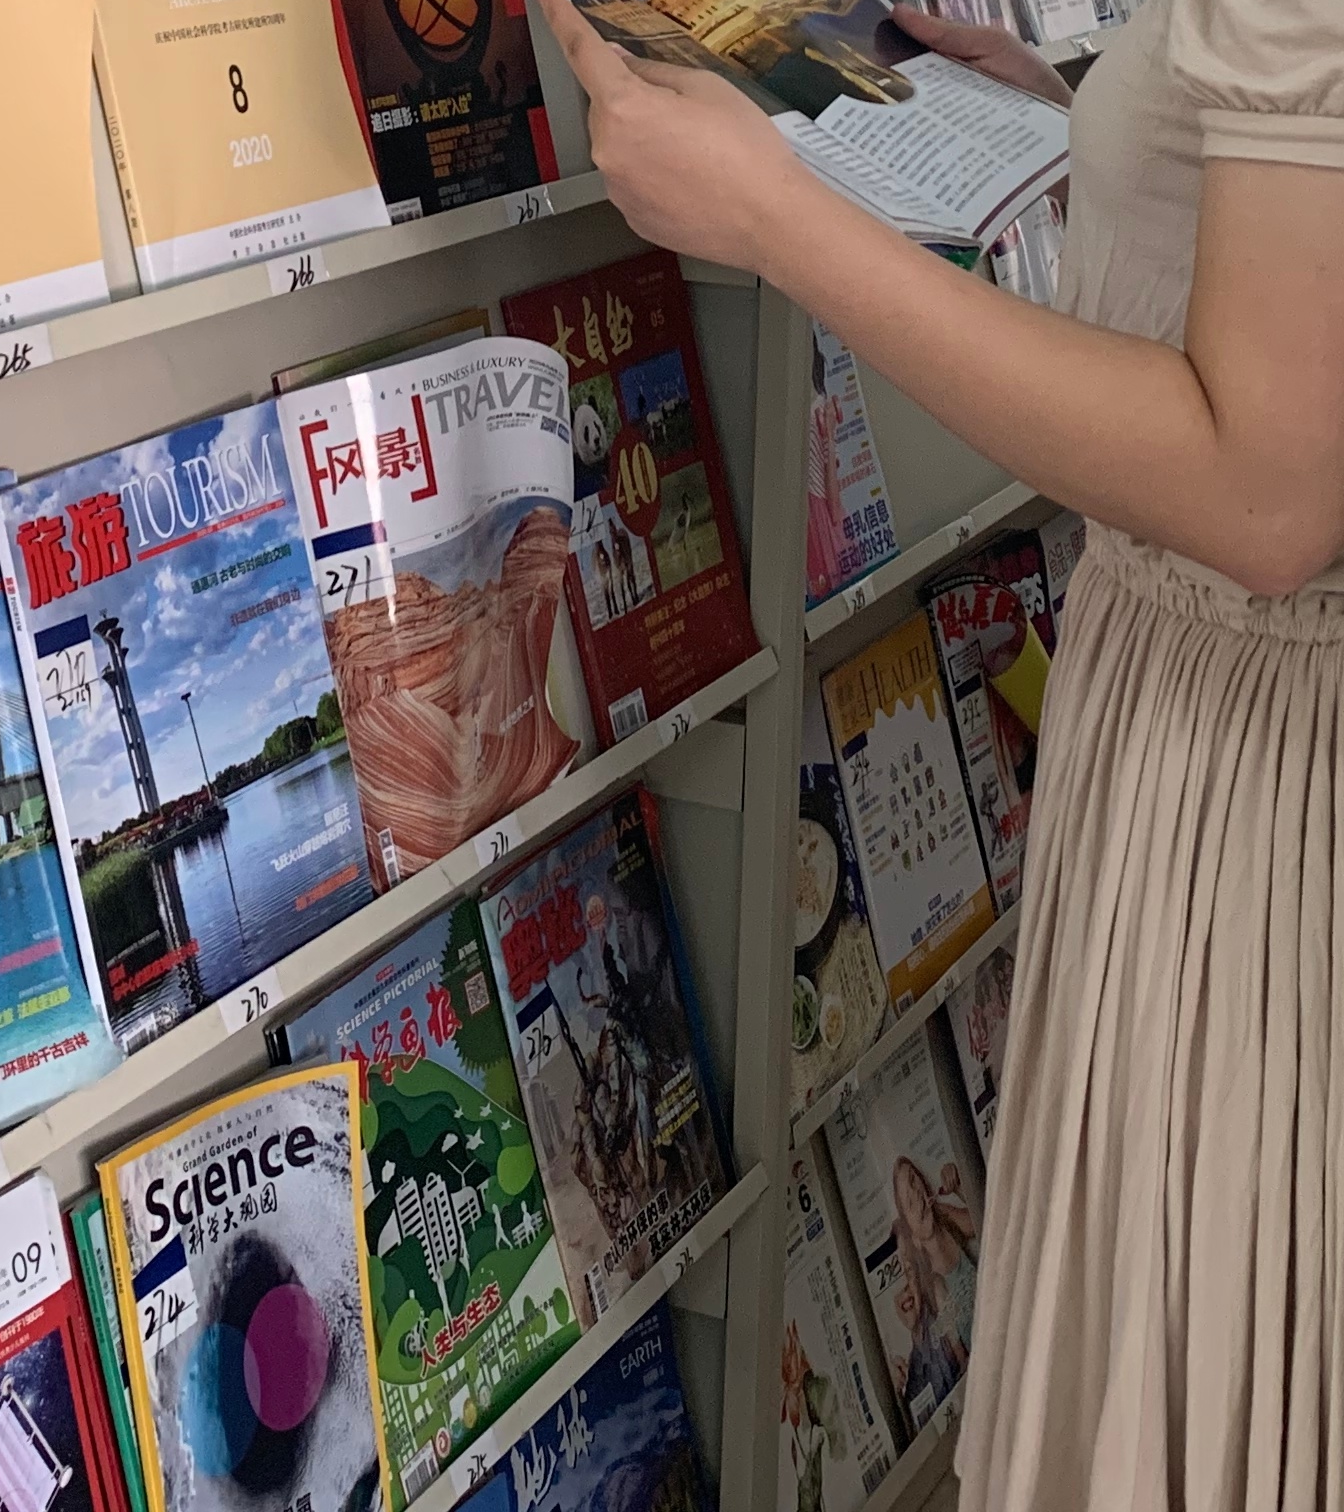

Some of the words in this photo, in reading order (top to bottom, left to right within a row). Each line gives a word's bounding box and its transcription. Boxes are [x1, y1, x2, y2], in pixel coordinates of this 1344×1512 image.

[228, 64, 249, 114] 8
[229, 133, 273, 169] 2020
[287, 253, 316, 293] 266
[422, 367, 470, 392] BUSINESS
[476, 355, 527, 371] LUXURY
[325, 426, 418, 496] 风景
[614, 440, 660, 515] 40
[16, 491, 132, 610] 旅游
[118, 434, 284, 548] TOURISM
[841, 498, 891, 543] 母乳信息
[837, 523, 895, 577] 运动的好处
[325, 554, 373, 607] 271
[241, 986, 269, 1023] 270
[336, 1000, 382, 1040] SCIENCE
[383, 956, 441, 1003] PICTORIAL
[182, 1151, 209, 1174] Grand
[209, 1135, 245, 1159] Garden
[246, 1126, 258, 1142] of
[145, 1124, 317, 1243] Science
[188, 1181, 278, 1256] 科学大观园
[649, 1179, 712, 1257] 其实并不环保
[11, 1241, 42, 1284] 09
[876, 1253, 902, 1291] 298
[144, 1289, 186, 1342] 274
[420, 1280, 502, 1378] 人类与生态
[618, 1337, 663, 1380] EARTH
